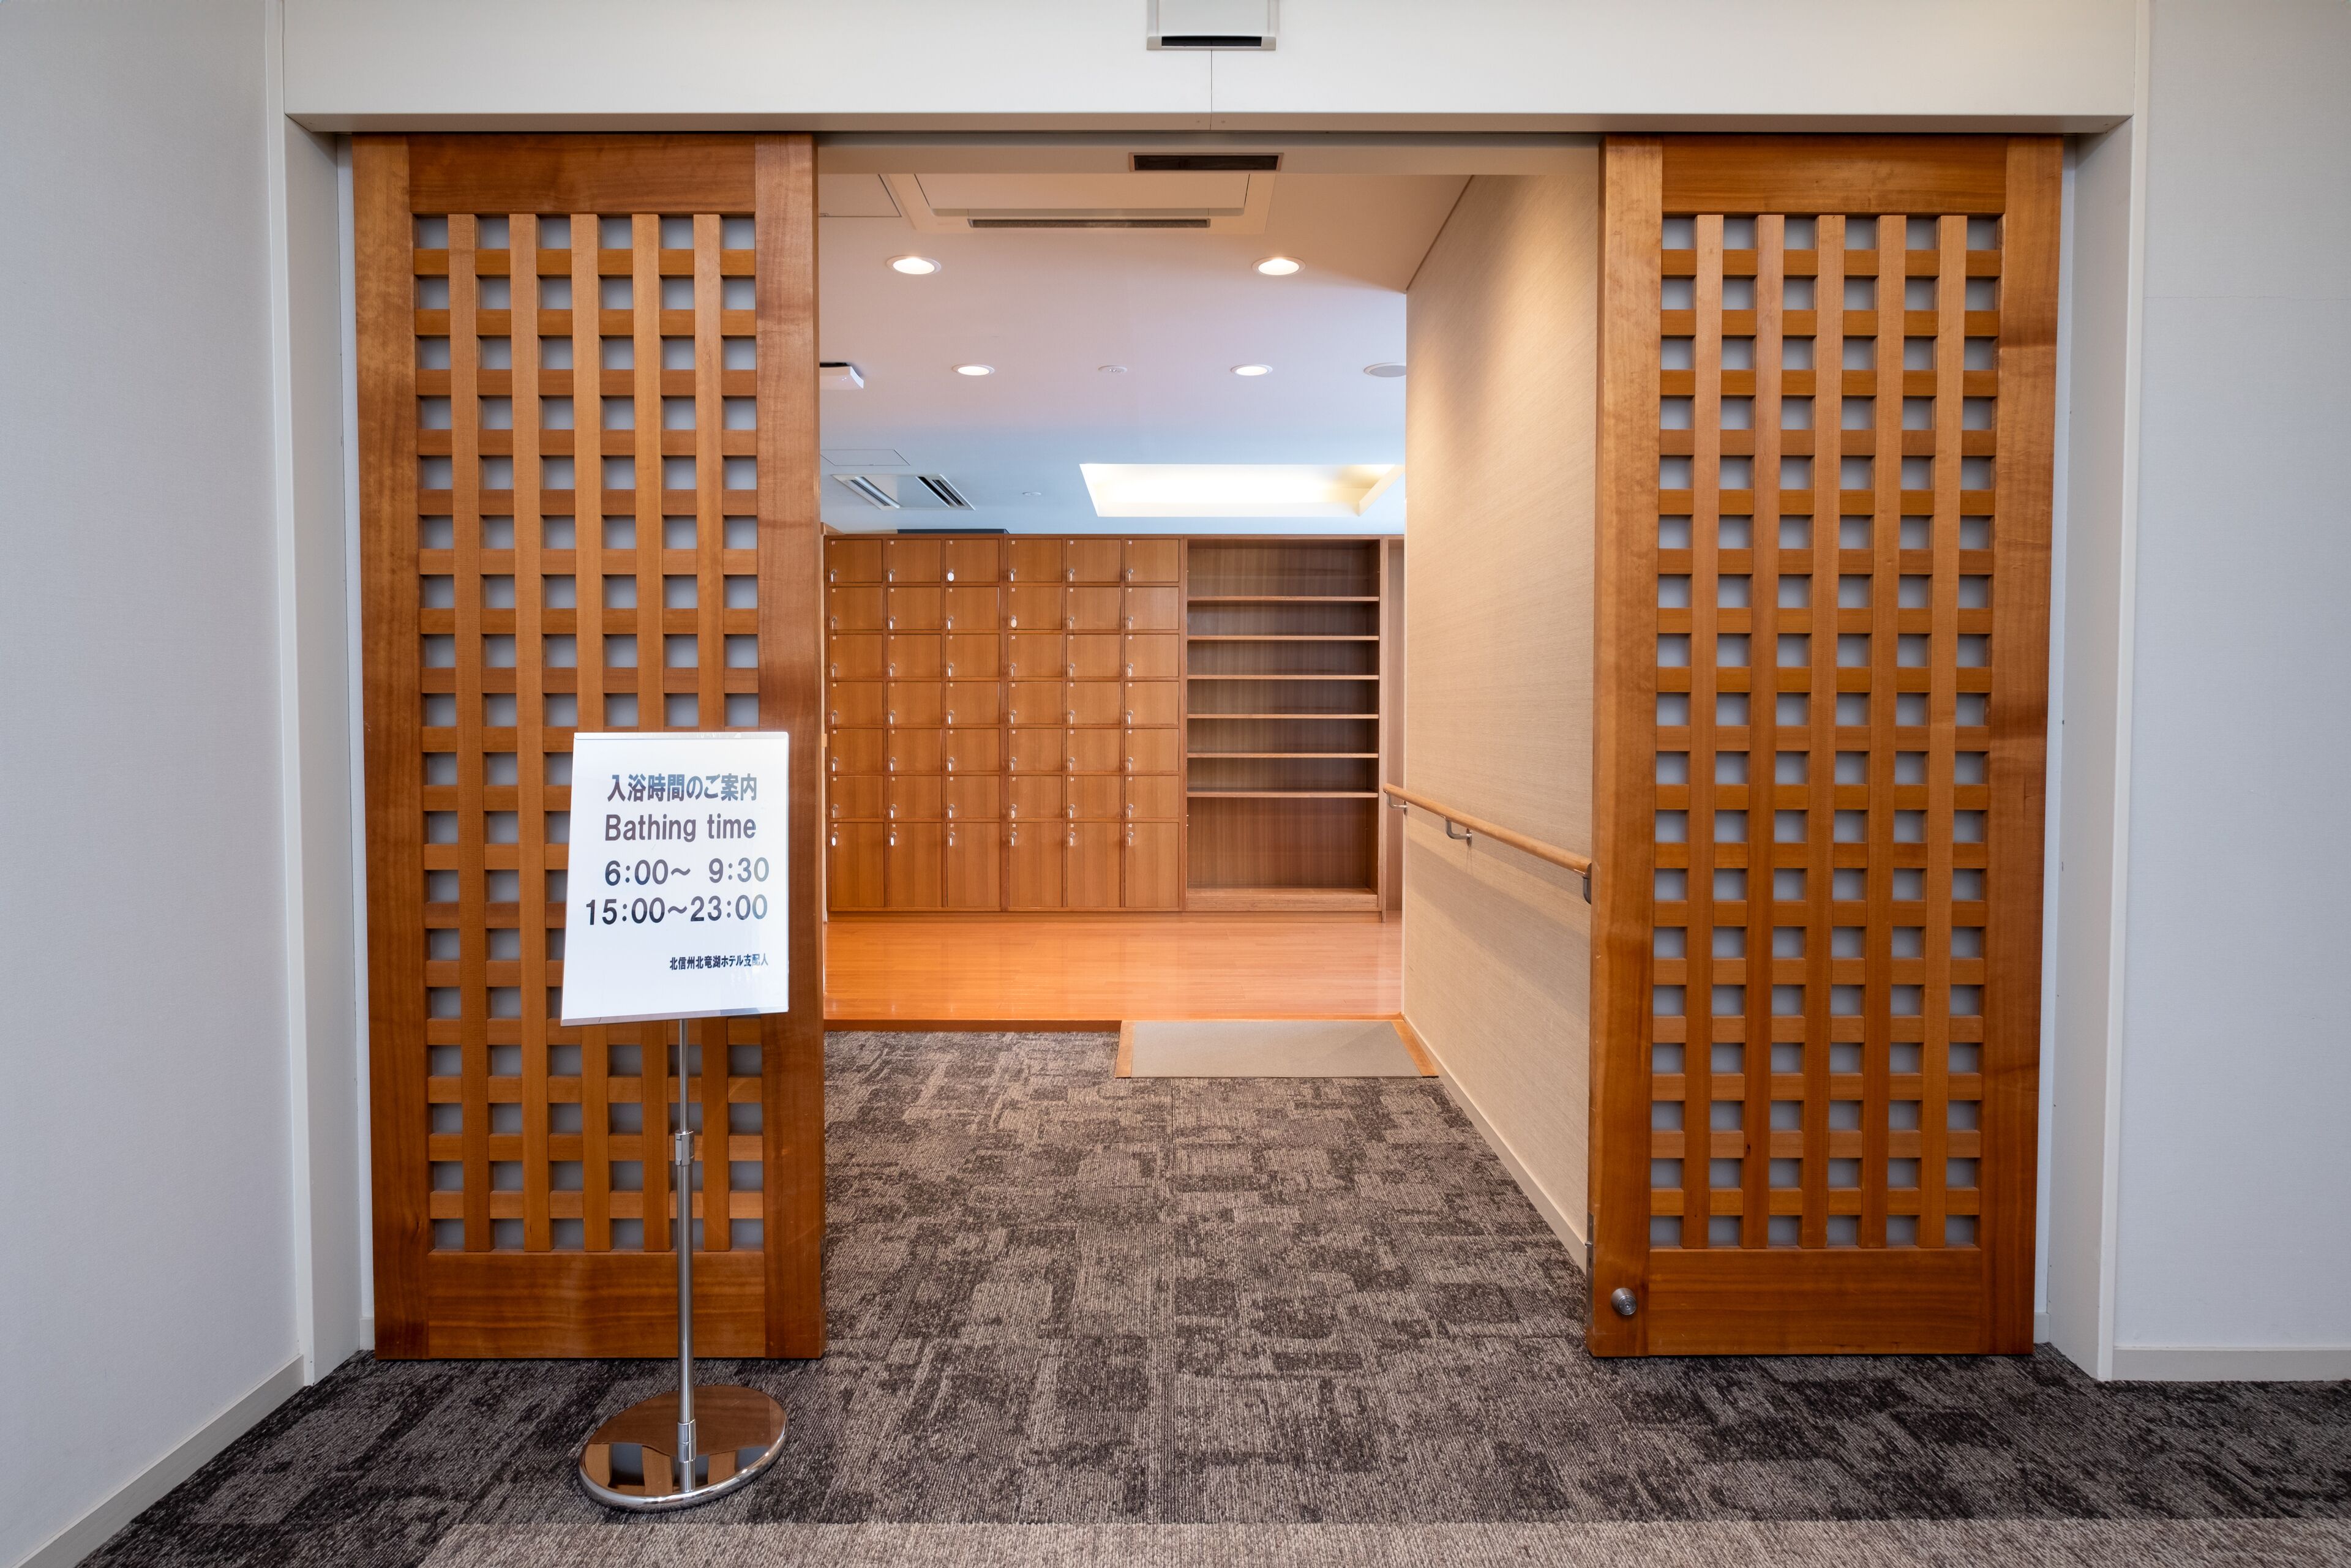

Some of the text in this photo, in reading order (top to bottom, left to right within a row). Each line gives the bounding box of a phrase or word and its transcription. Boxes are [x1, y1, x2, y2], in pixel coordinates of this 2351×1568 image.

[607, 773, 757, 802] 入浴時間のご案内
[604, 812, 757, 843] Bathing time
[708, 857, 770, 883] 9:30
[669, 953, 769, 971] 北信州北竜湖ホテル支配人
